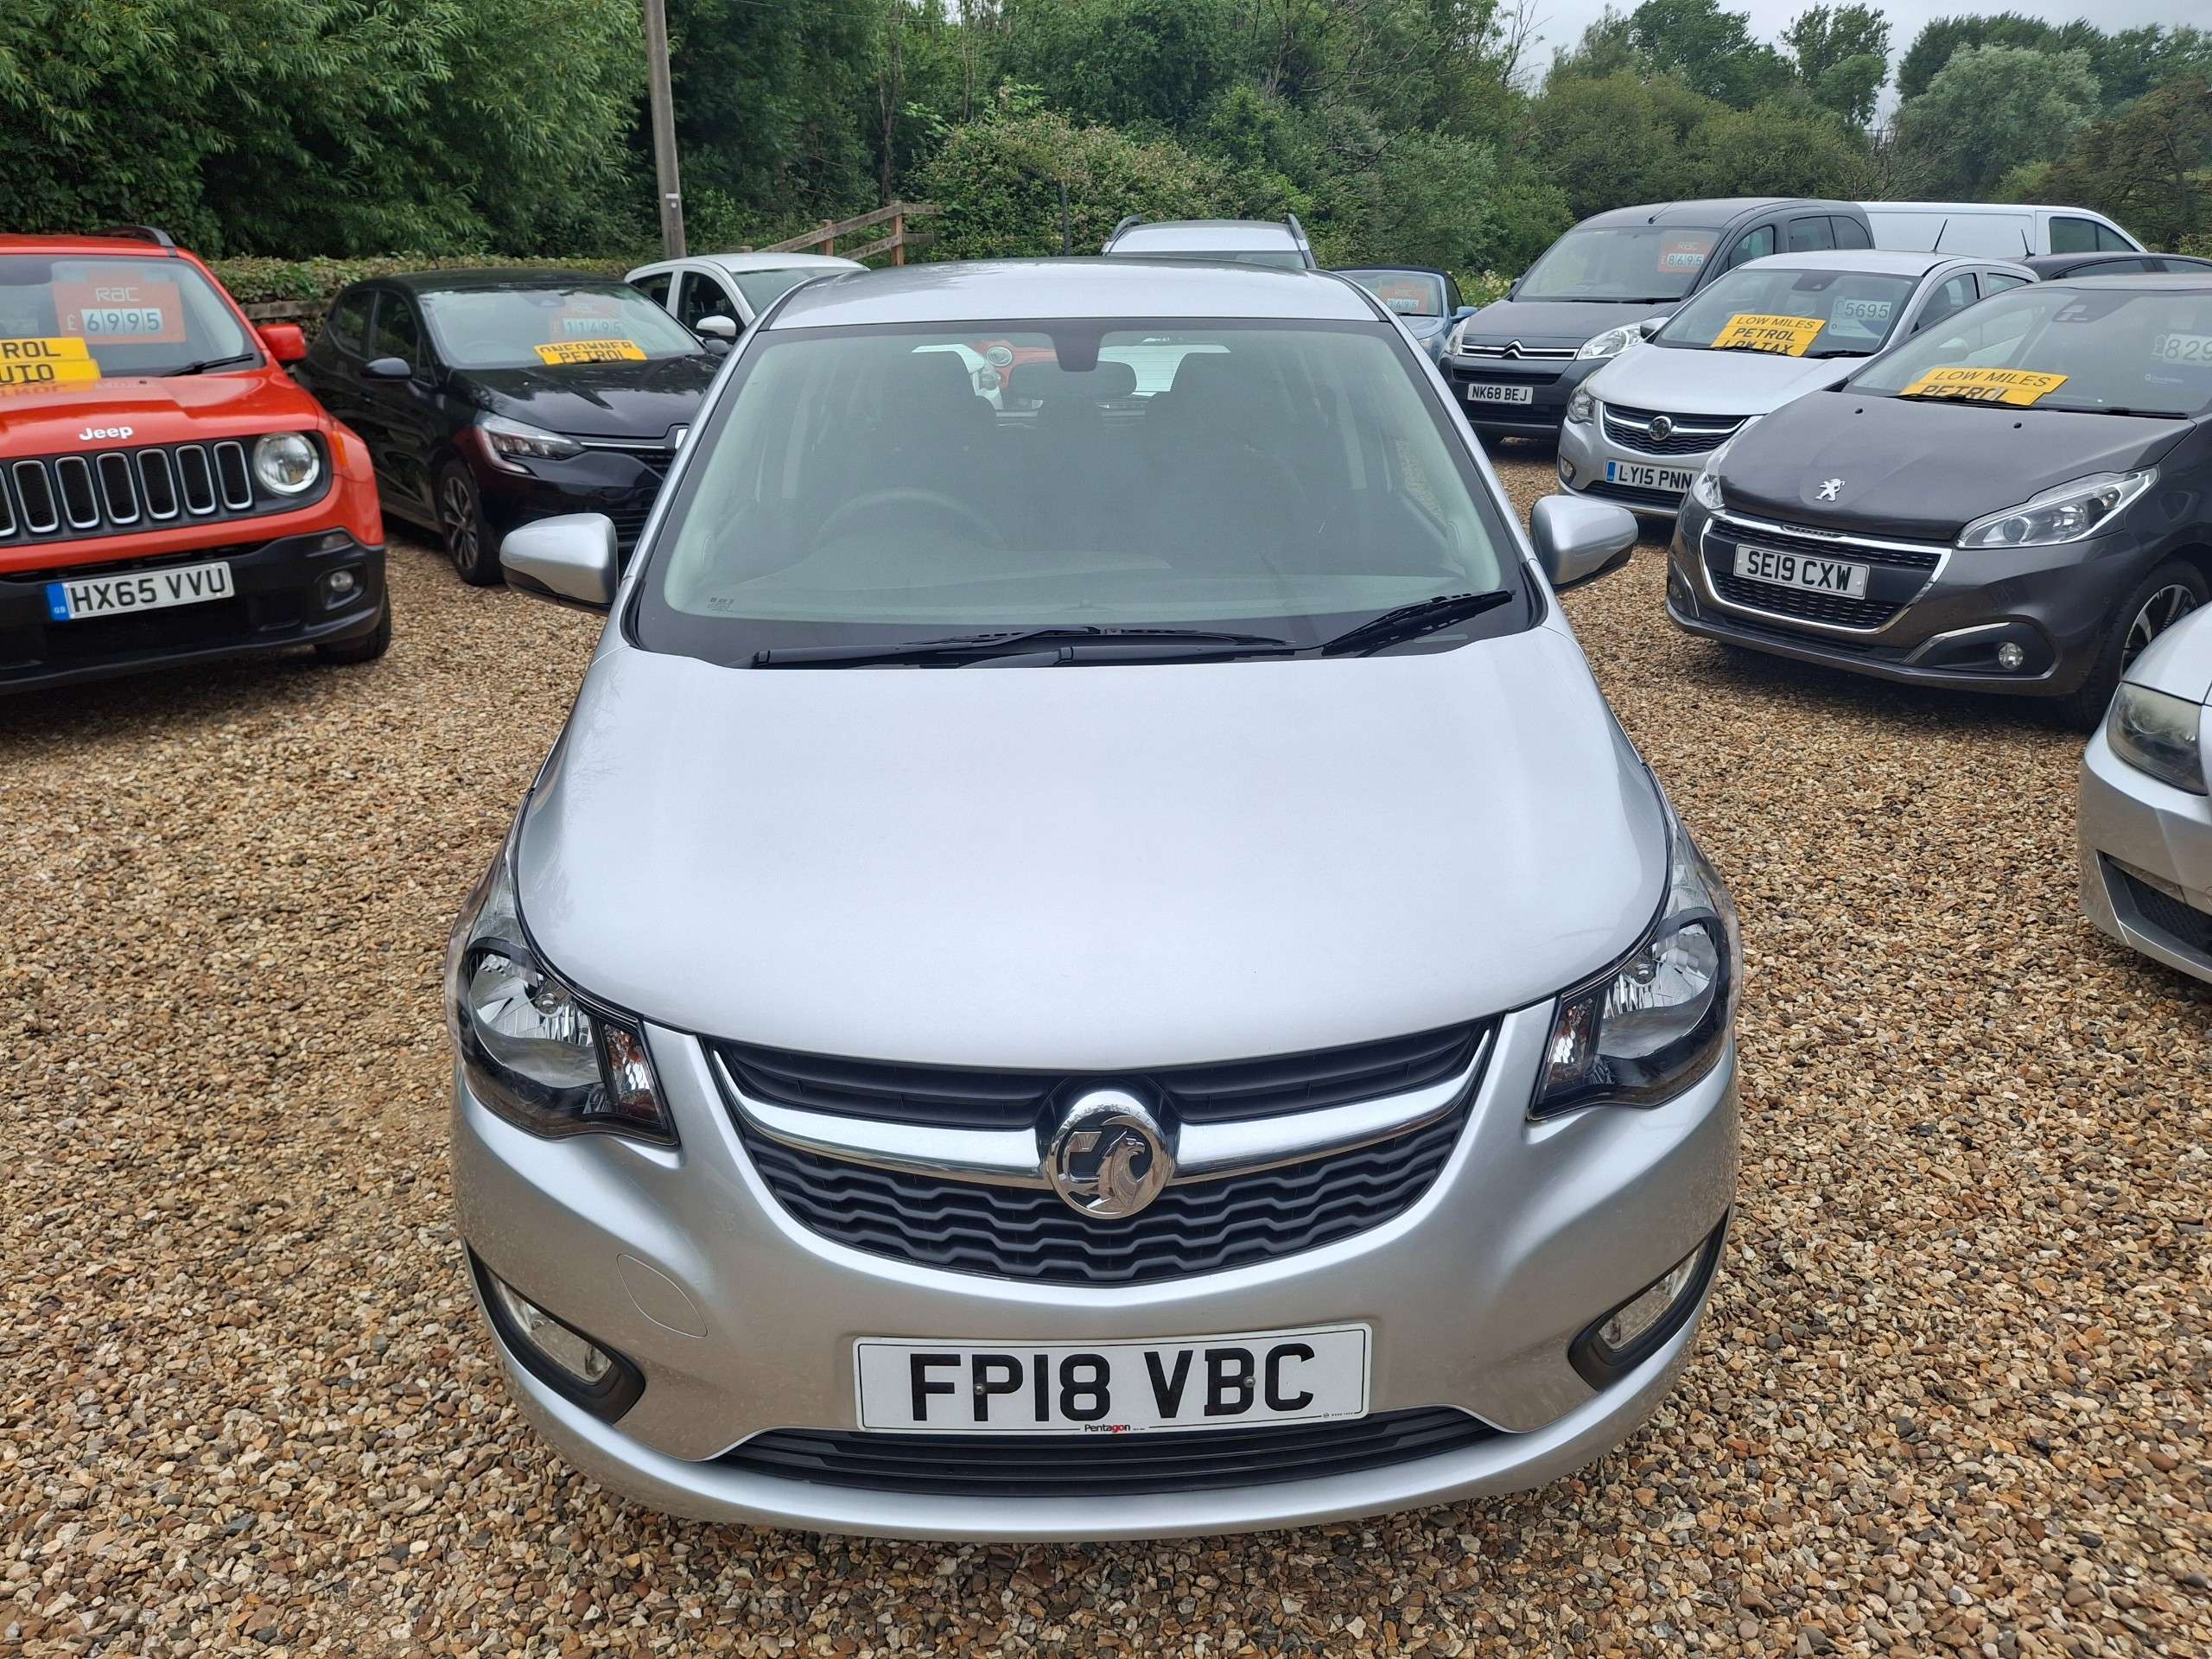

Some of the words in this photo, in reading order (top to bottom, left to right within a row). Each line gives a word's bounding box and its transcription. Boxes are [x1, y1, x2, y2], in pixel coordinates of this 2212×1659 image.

[1737, 316, 1770, 325] LOW
[1771, 317, 1815, 329] MILES
[1732, 327, 1796, 341] PETROL
[1763, 341, 1794, 354] TAX
[1935, 371, 1984, 381] LOW
[1984, 372, 2051, 387] MILES
[1471, 385, 1502, 400] NK68
[1504, 388, 1528, 402] BEJ
[79, 426, 133, 441] Jeep
[1618, 465, 1655, 485] LY15
[1658, 469, 1693, 490] PNN
[1746, 550, 1796, 582] SE19
[1802, 560, 1853, 591] CXW
[70, 577, 157, 613] HX65
[165, 568, 226, 600] VVU
[909, 1352, 1112, 1422] FP18
[1143, 1342, 1316, 1419] VBC
[1084, 1423, 1131, 1433] Pentagon
